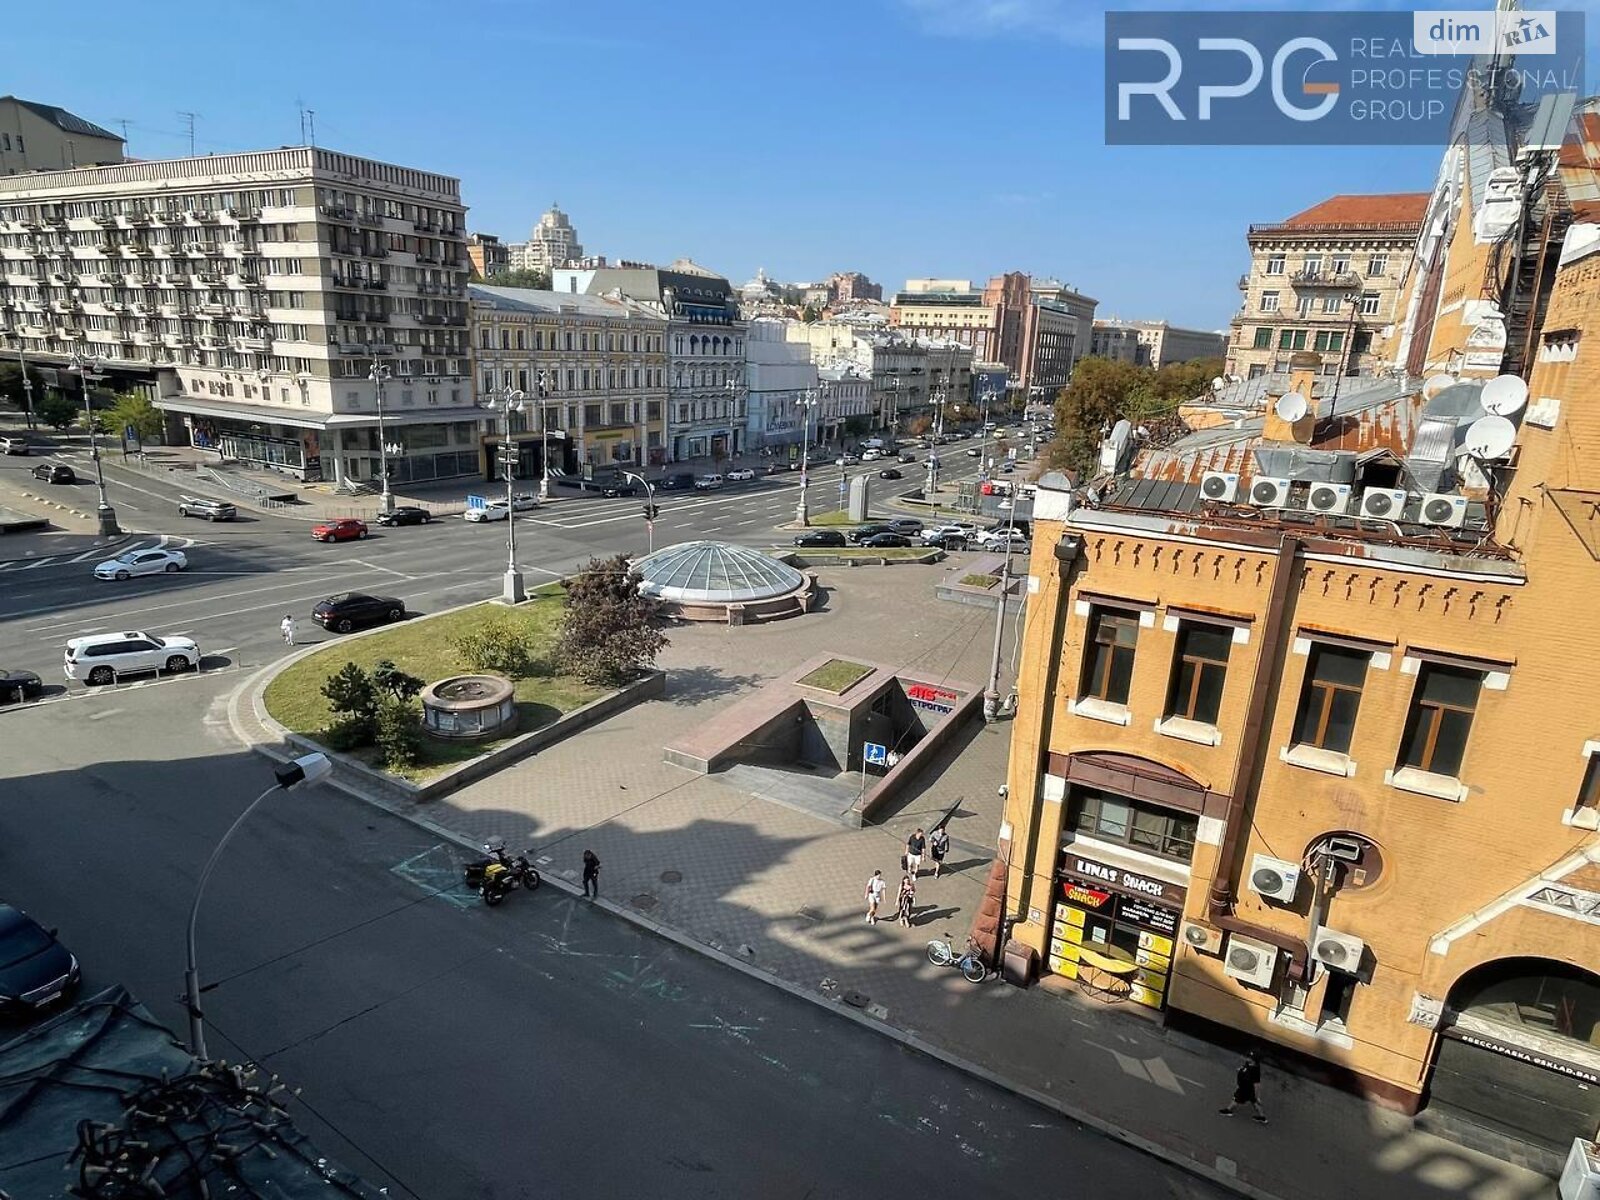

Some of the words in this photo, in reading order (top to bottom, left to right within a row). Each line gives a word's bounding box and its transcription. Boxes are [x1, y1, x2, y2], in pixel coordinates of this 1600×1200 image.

[1077, 860, 1117, 882] LINAS
[1123, 874, 1162, 896] SNACK
[1068, 889, 1100, 908] SNACK
